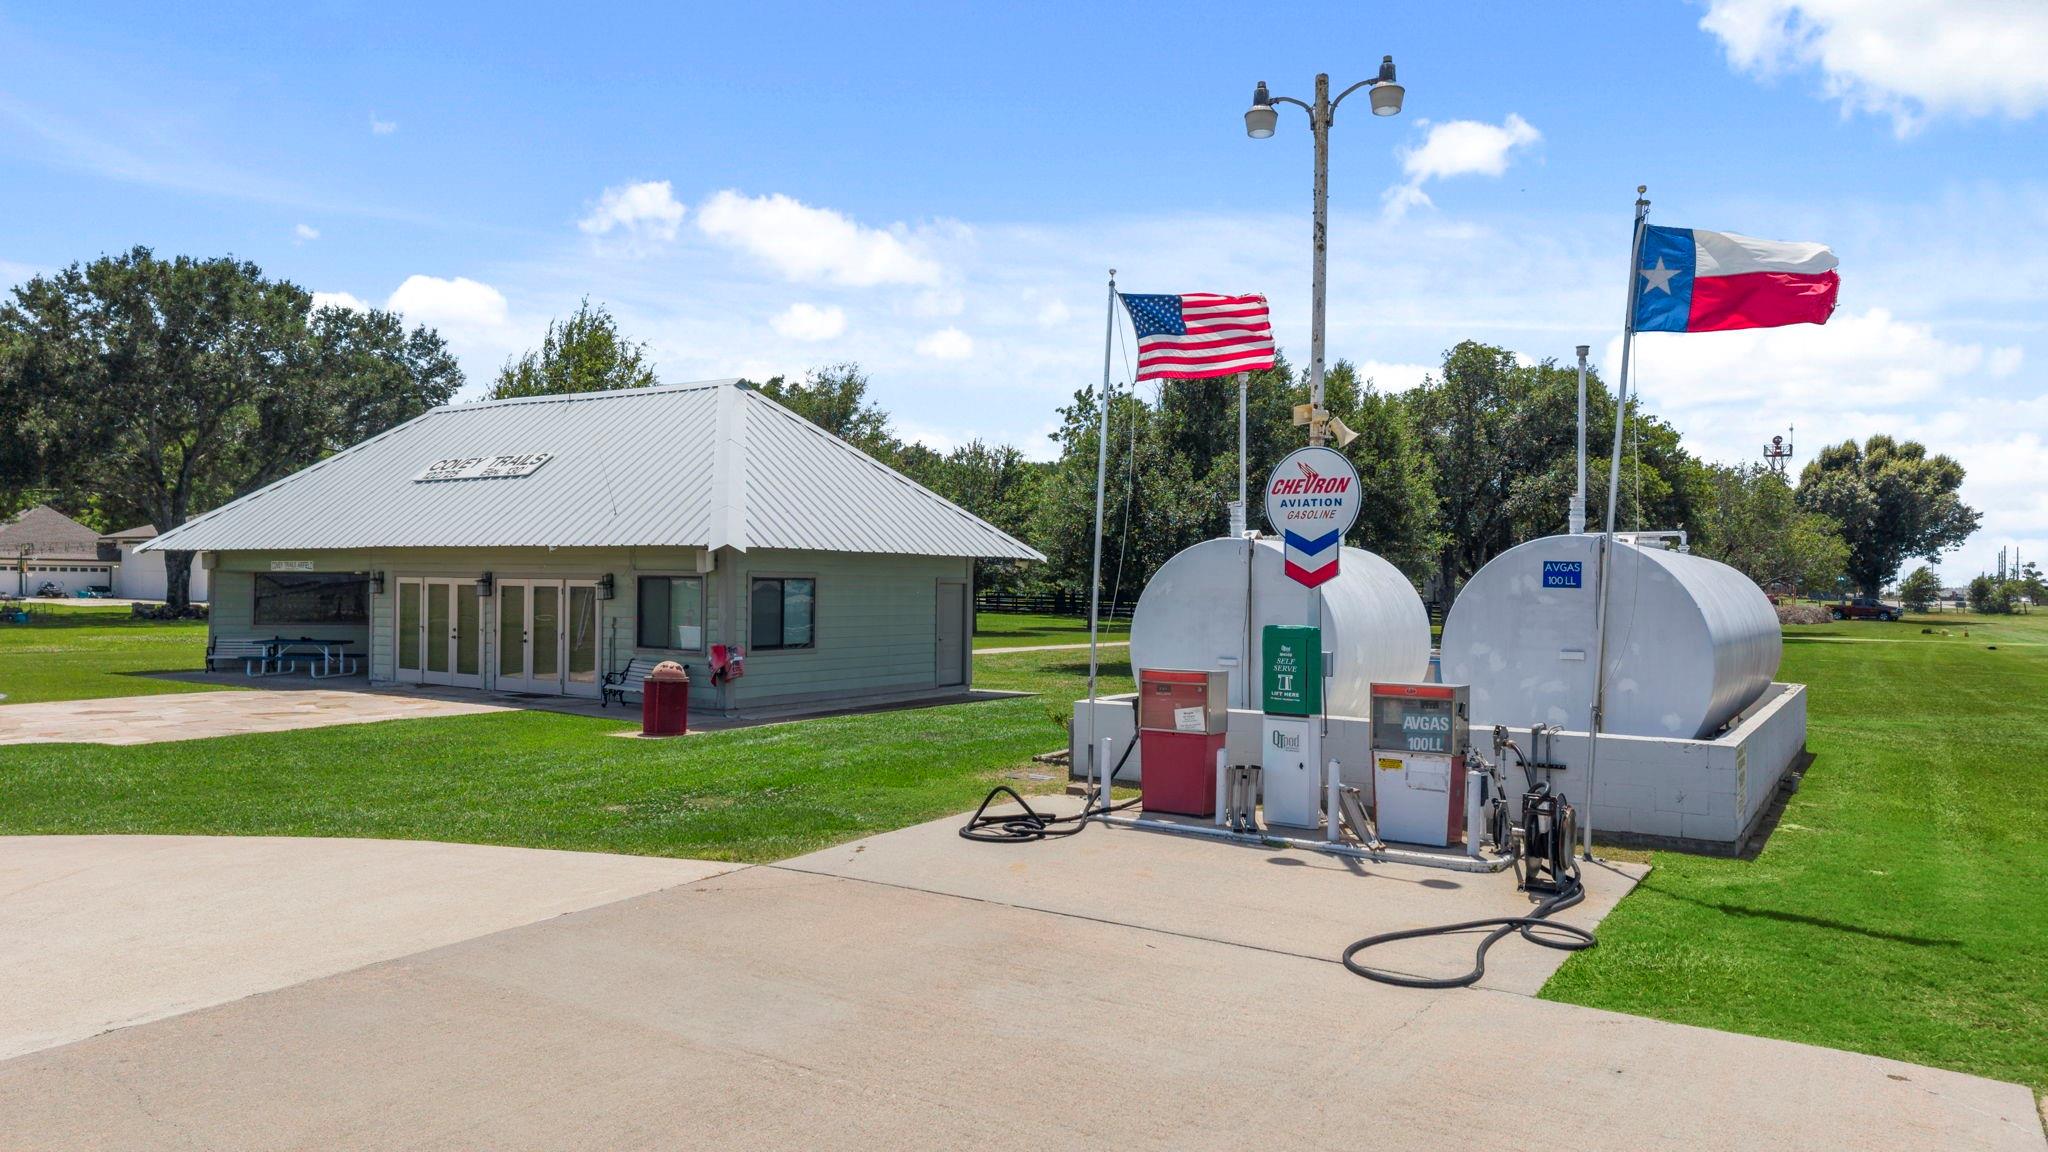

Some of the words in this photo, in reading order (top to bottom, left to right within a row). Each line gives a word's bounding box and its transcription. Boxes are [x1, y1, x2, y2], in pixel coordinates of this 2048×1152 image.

[429, 457, 488, 471] COVEY
[487, 453, 548, 468] TRAILS
[1271, 473, 1352, 495] CHEVRON
[1280, 498, 1343, 508] AVIATION
[1287, 510, 1337, 519] GASOLINE
[1545, 563, 1580, 571] AVGAS
[1548, 576, 1564, 585] 100
[1565, 576, 1576, 585] LL
[1276, 657, 1296, 665] SELF
[1272, 665, 1298, 673] SERVE
[1402, 716, 1450, 732] AVGAS
[1272, 729, 1300, 749] QTpod
[1407, 737, 1444, 751] 100LL
